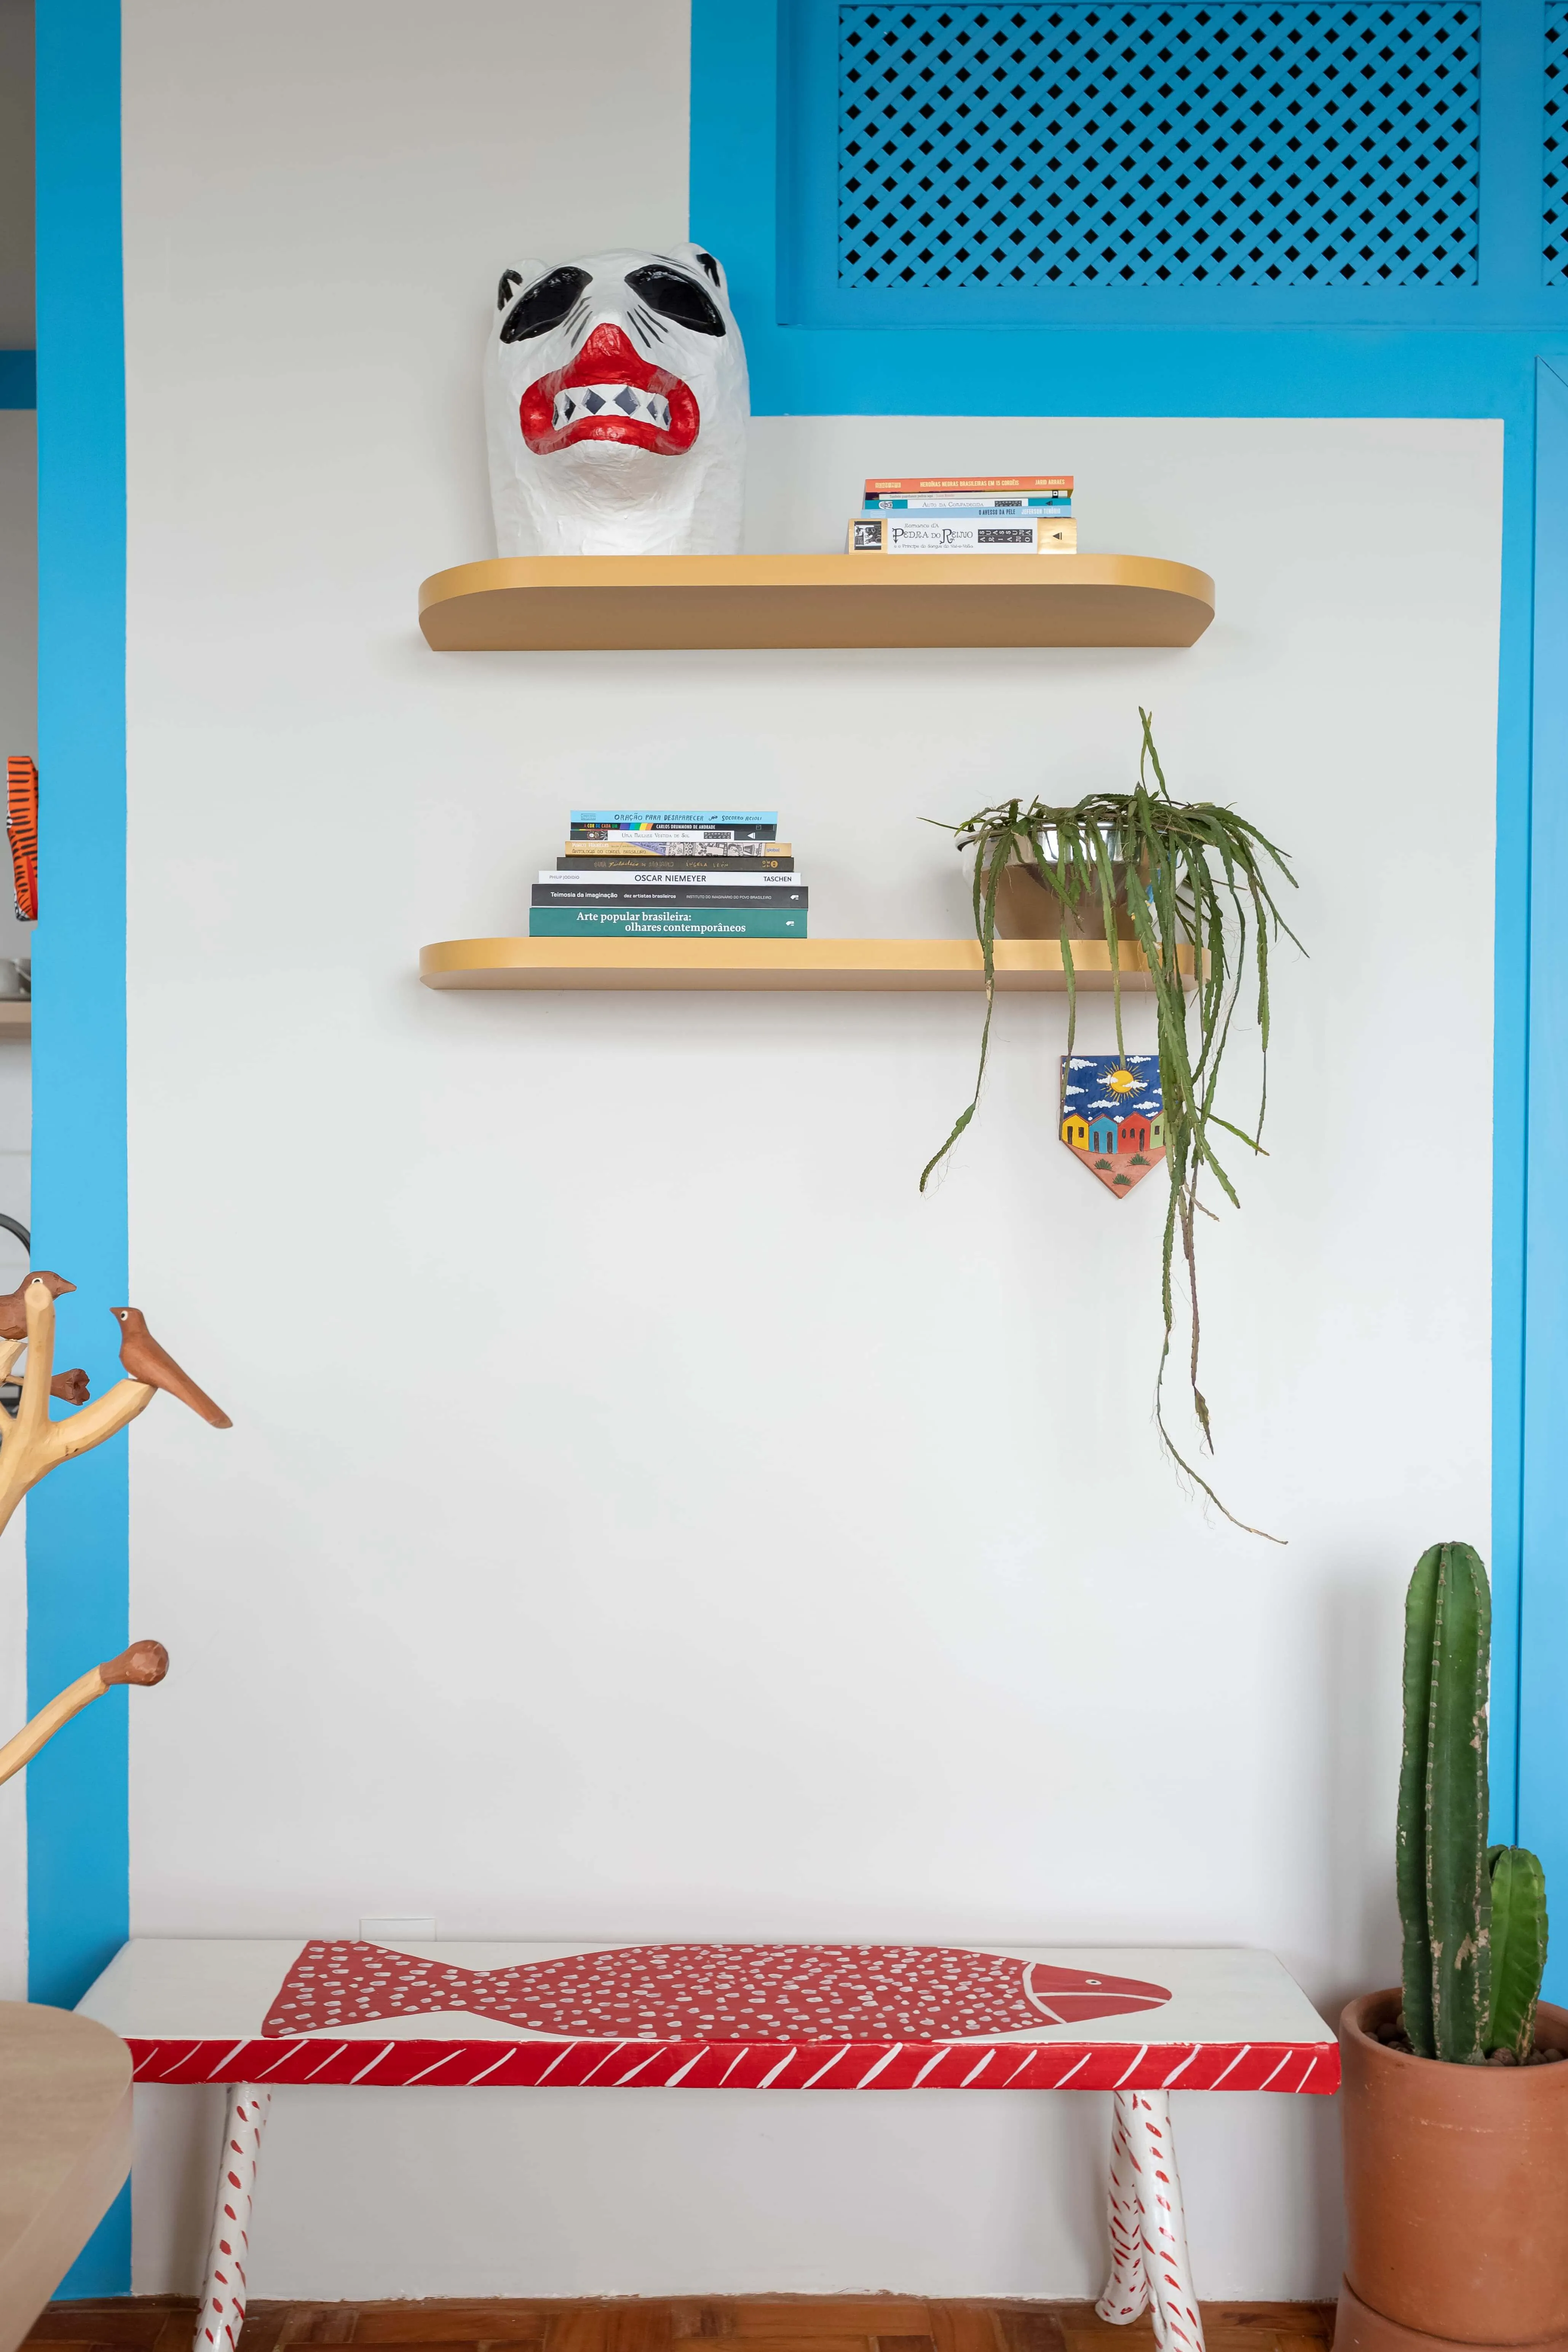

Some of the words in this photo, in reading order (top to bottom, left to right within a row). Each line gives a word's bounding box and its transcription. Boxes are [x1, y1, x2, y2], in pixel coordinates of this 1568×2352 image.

[614, 813, 642, 821] ORAÇÃO
[576, 912, 598, 921] Arte
[600, 912, 640, 923] popular
[642, 912, 691, 921] brasileira:
[625, 923, 661, 932] olhares
[663, 923, 746, 934] contemporâneos
